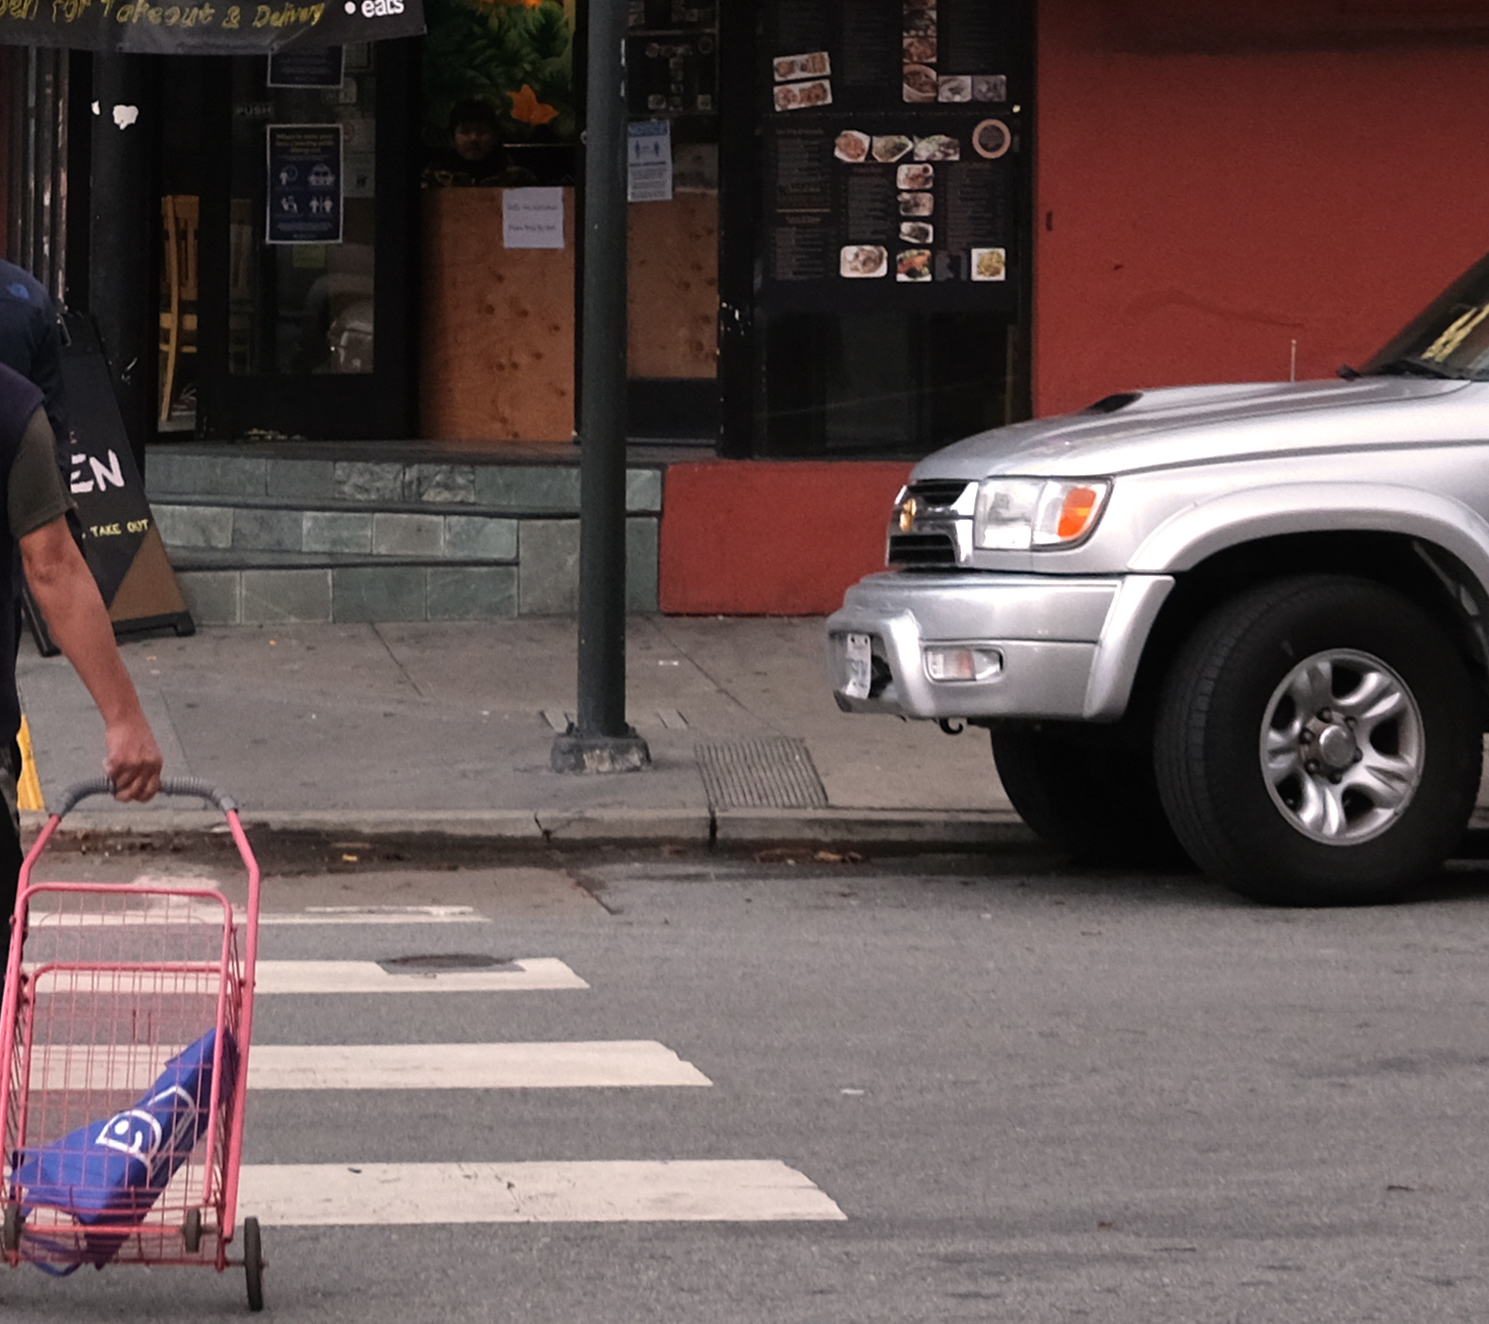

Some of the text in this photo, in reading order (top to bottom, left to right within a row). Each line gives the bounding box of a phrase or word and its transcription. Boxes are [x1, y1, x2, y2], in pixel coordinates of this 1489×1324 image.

[70, 449, 125, 494] EN
[89, 519, 149, 538] TAKE OUT
